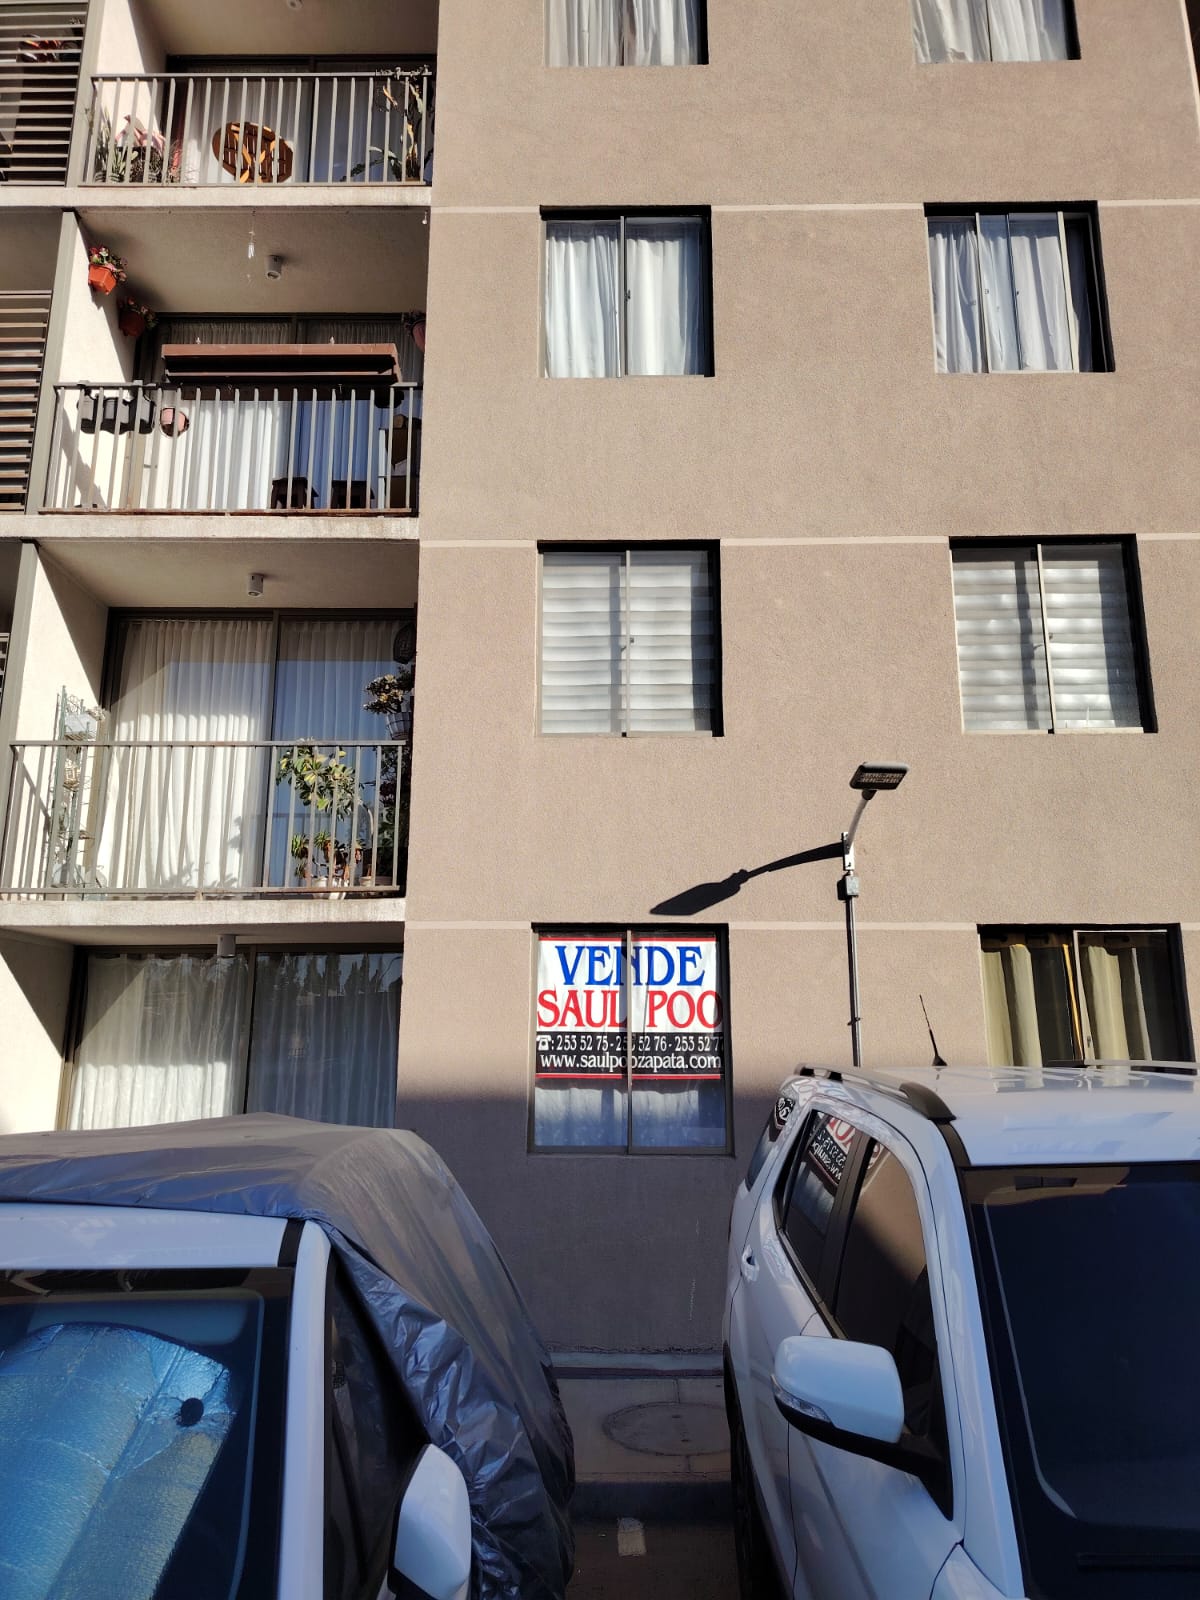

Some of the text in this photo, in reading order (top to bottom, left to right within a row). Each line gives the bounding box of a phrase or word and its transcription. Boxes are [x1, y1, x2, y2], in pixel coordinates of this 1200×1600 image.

[555, 945, 705, 986] VENDE
[537, 989, 722, 1029] SAUL POO
[674, 1035, 695, 1052] 253
[697, 1036, 711, 1052] 52
